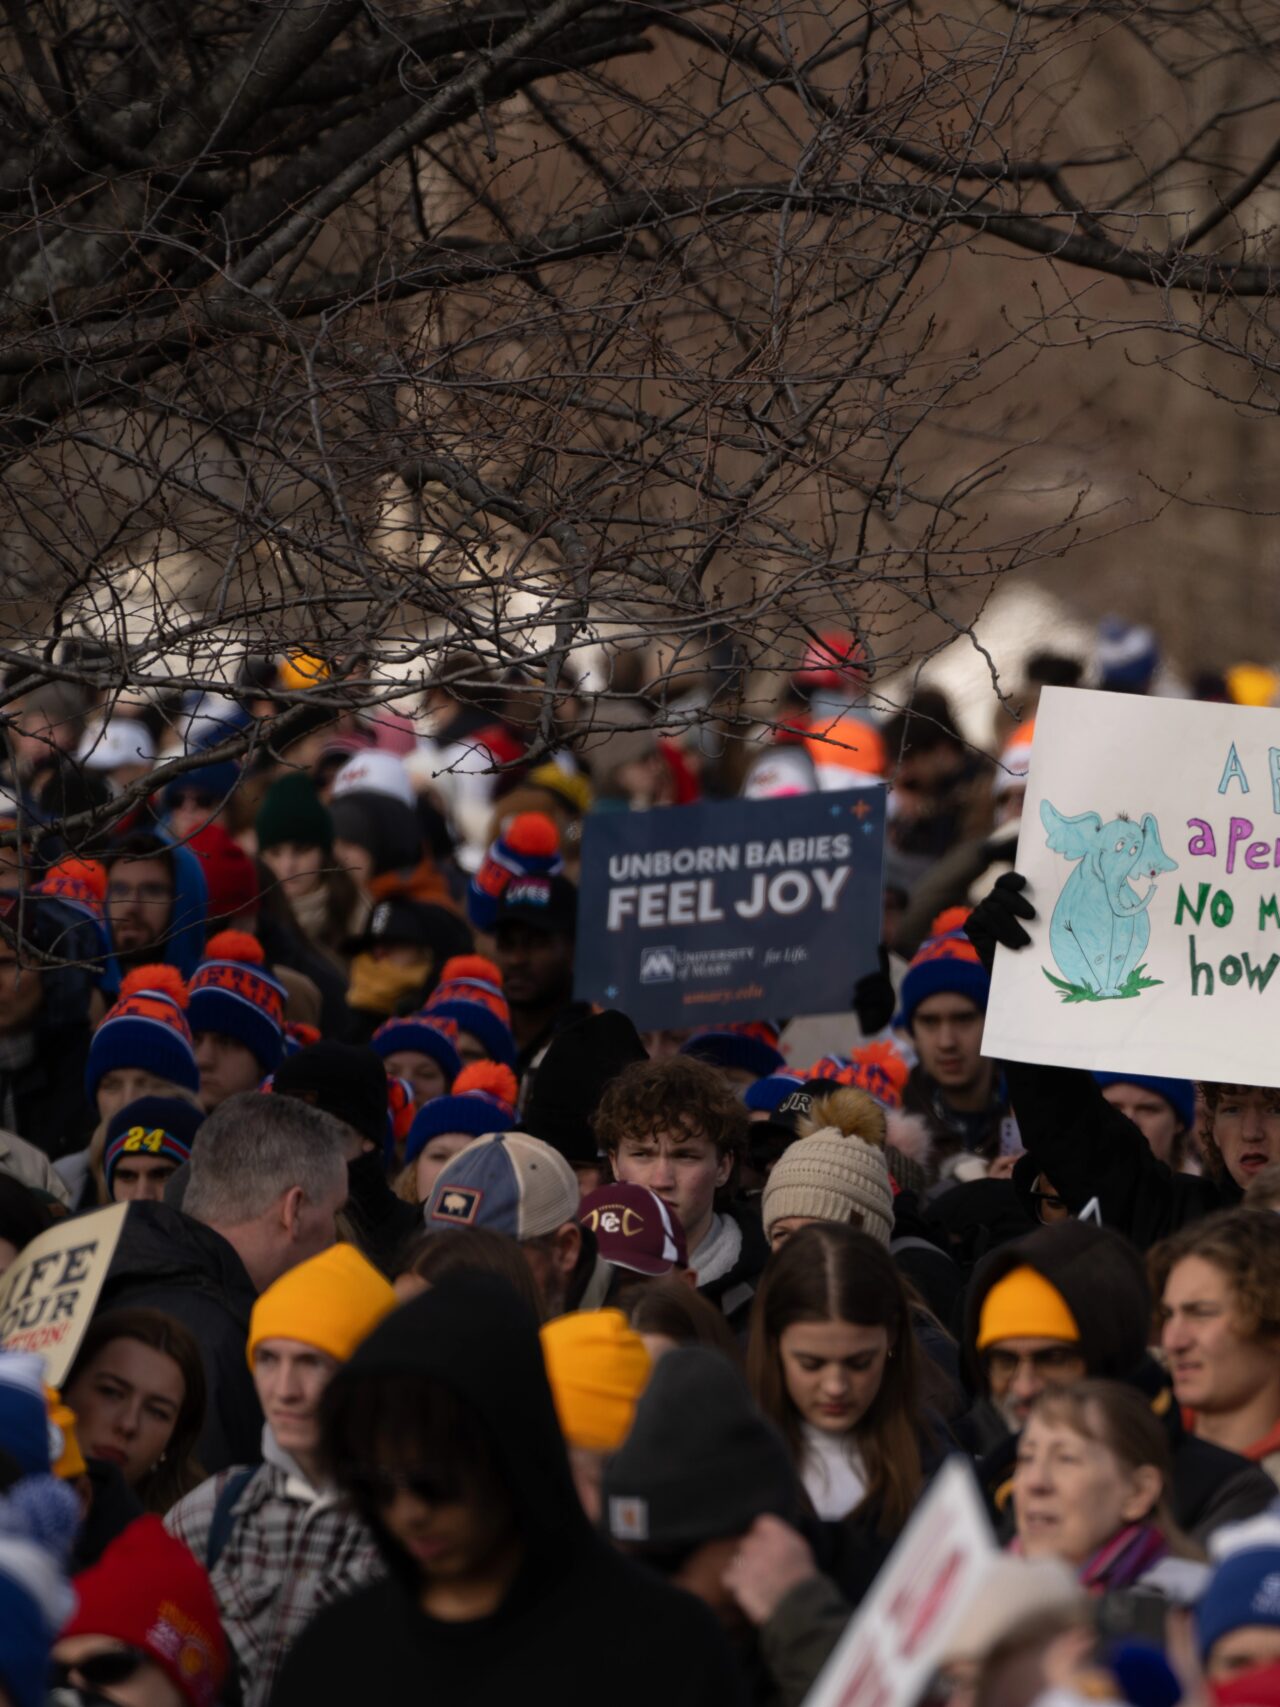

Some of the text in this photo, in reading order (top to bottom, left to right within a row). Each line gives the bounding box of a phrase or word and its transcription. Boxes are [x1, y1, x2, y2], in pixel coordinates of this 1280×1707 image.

[1217, 741, 1250, 795] A
[608, 834, 852, 881] UNBORN BABIES
[1186, 818, 1217, 858] a
[606, 866, 851, 931] FEEL JOY
[123, 1126, 165, 1153] 24
[1, 1240, 98, 1312] IFE
